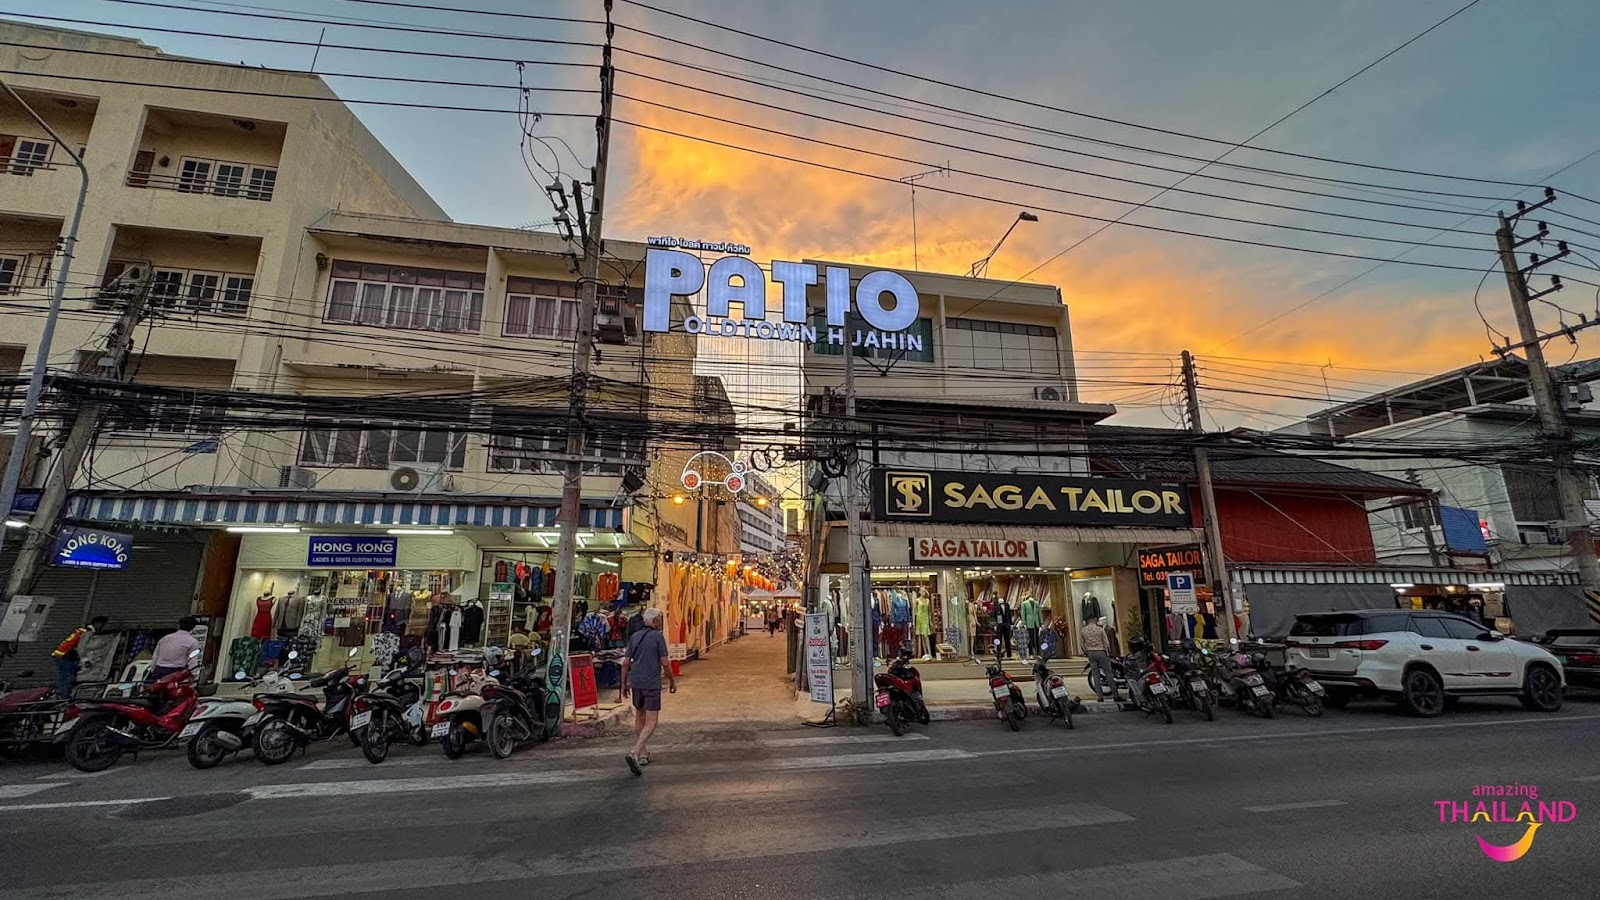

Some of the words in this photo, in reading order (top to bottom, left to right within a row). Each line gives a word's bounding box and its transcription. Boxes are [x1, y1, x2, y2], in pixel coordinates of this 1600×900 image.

[643, 248, 920, 332] PATIO
[943, 481, 1056, 511] SAGA
[1061, 486, 1186, 515] TAILOR
[60, 533, 98, 558] HONG
[100, 534, 128, 563] KONG
[312, 542, 353, 552] HONG
[356, 543, 394, 553] KONG
[919, 539, 970, 558] SAGA
[970, 540, 1029, 558] TAILOR
[1140, 553, 1165, 568] SAGA
[1166, 550, 1201, 567] TAILOR
[1176, 576, 1186, 589] P
